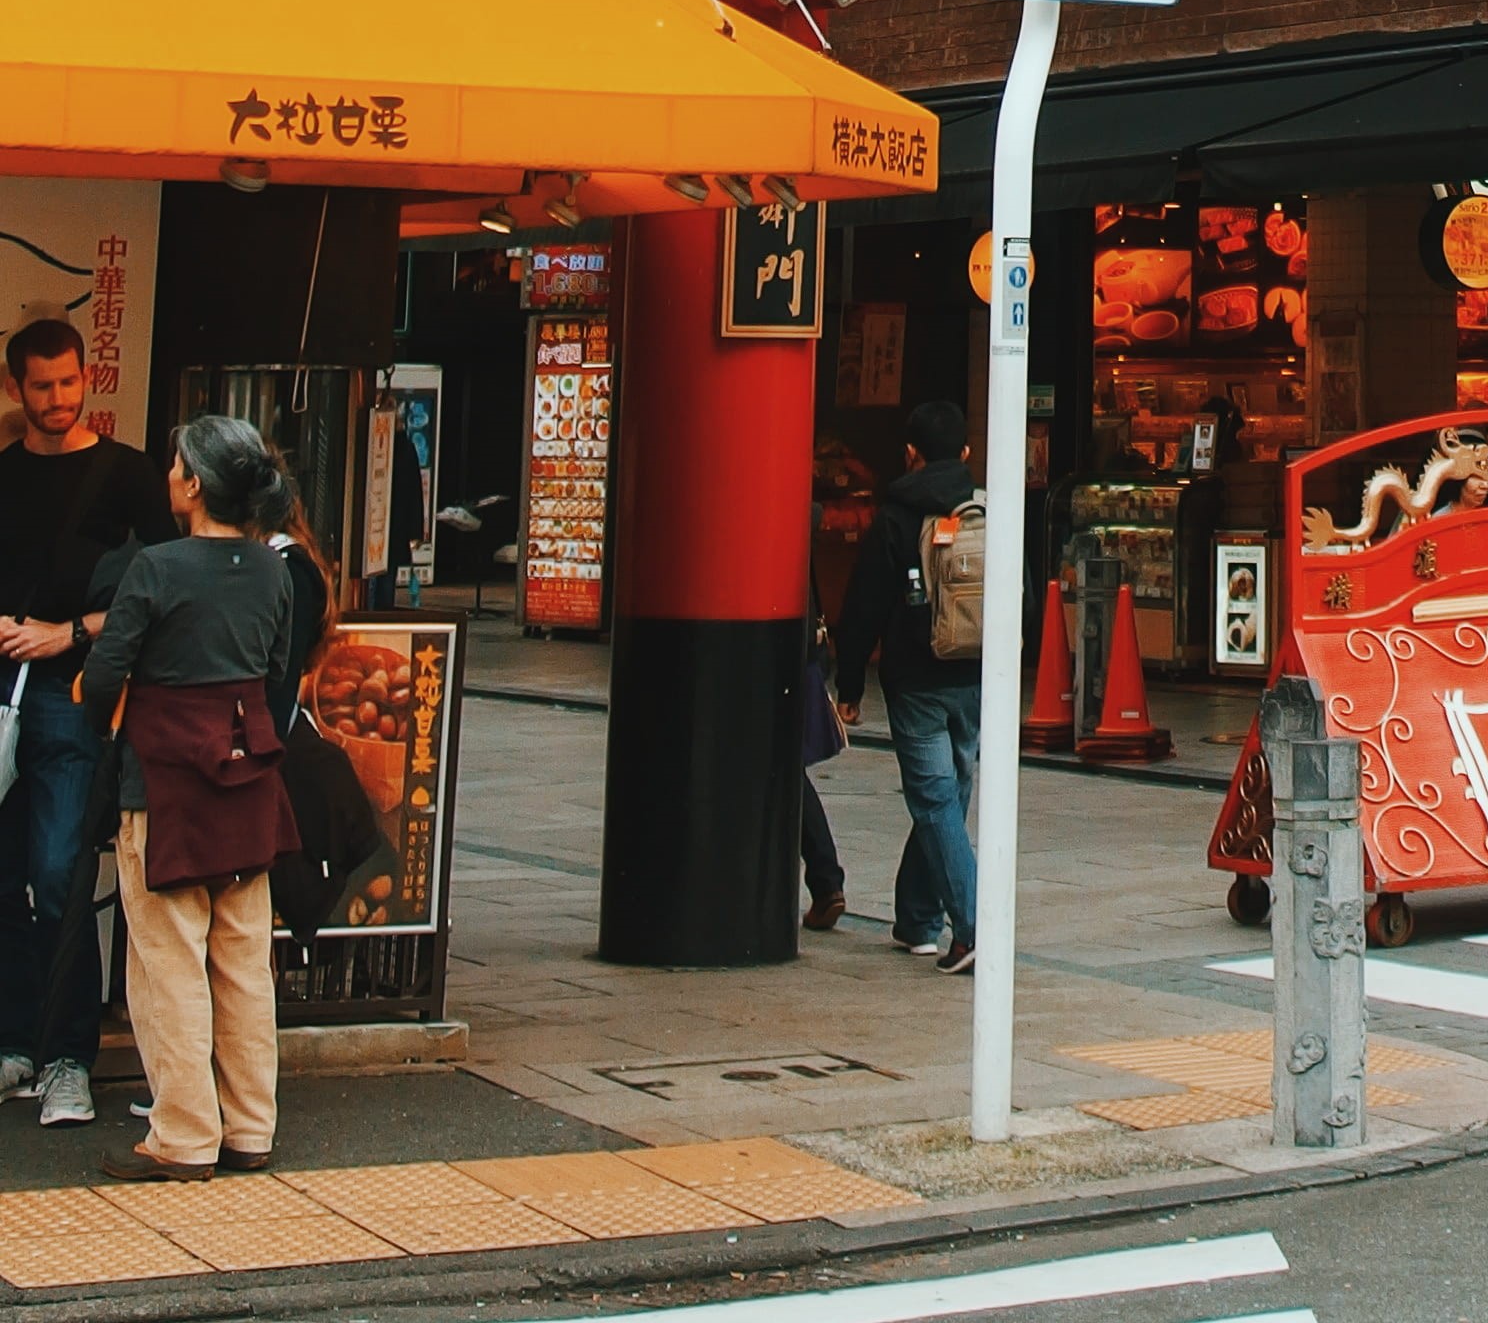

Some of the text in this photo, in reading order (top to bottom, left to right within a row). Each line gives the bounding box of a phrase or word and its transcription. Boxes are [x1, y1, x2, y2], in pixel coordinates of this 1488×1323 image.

[226, 88, 409, 150] 大粒甘栗
[832, 114, 928, 179] 横浜大飯店
[90, 234, 128, 396] 中華街名物
